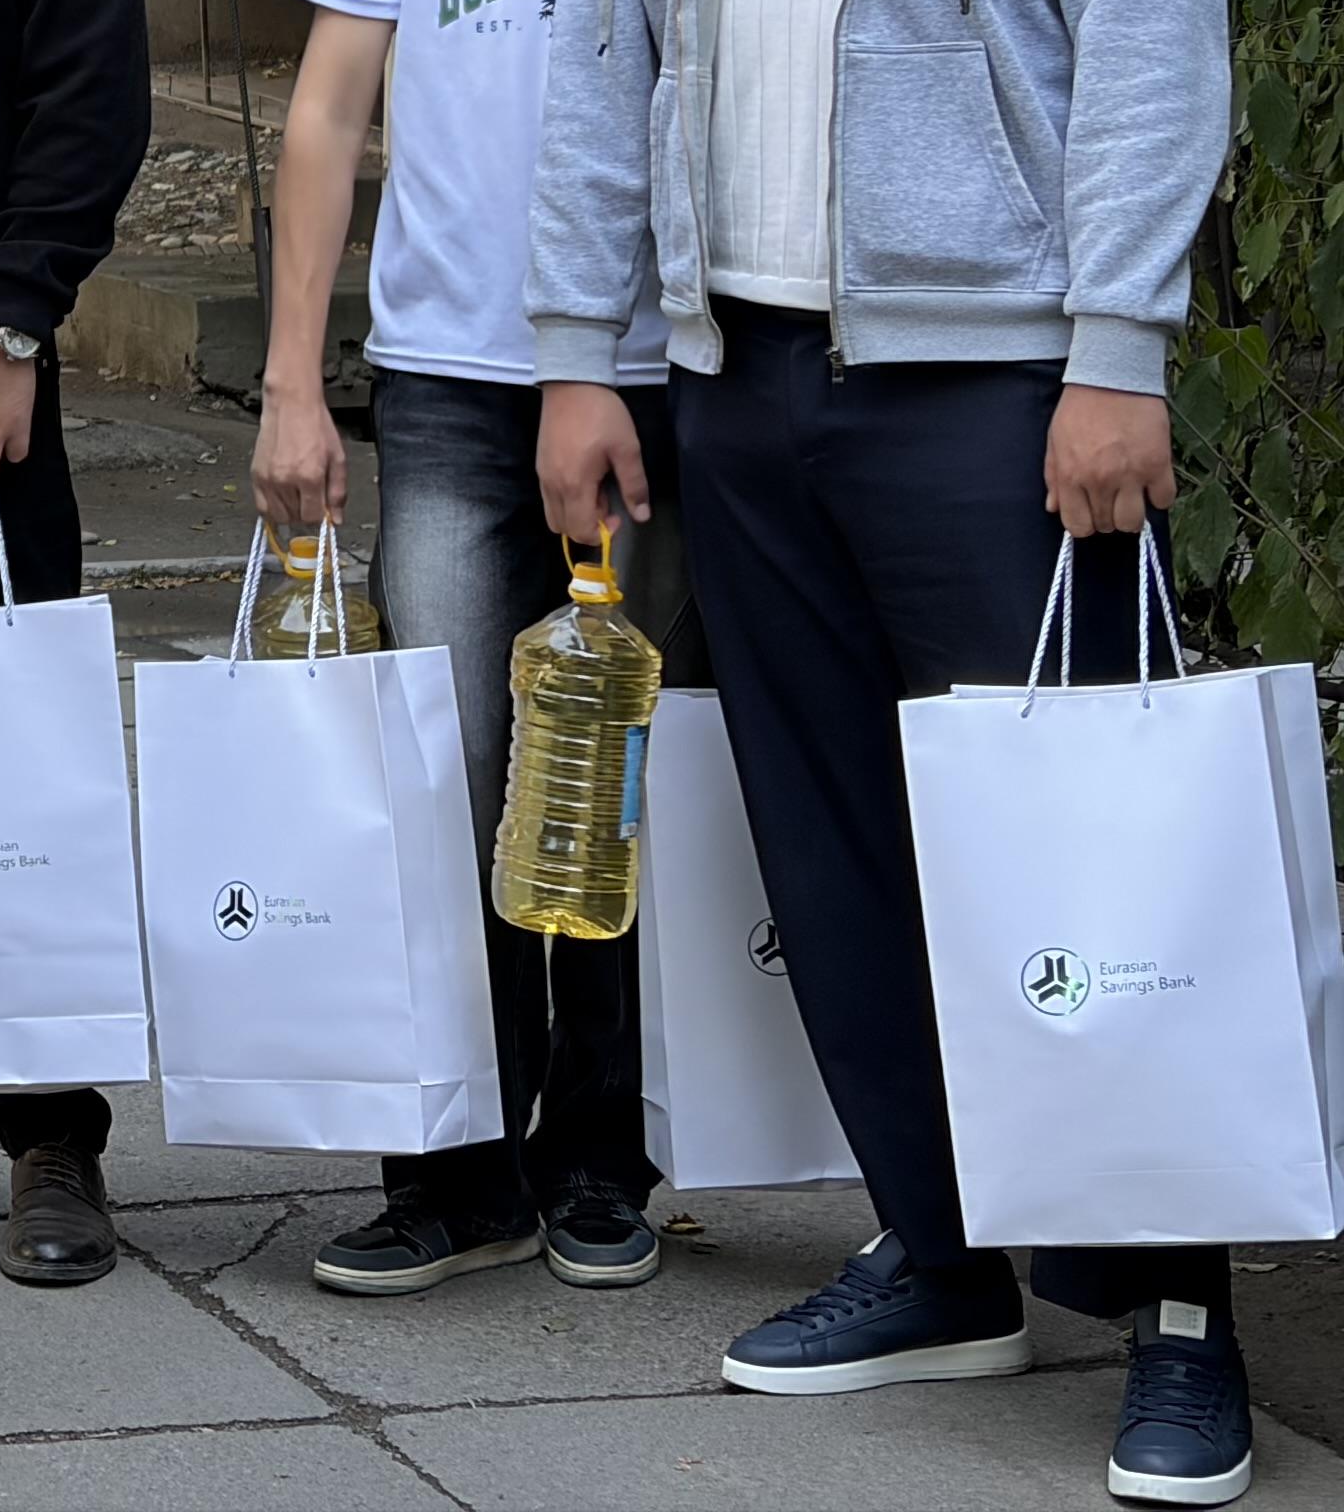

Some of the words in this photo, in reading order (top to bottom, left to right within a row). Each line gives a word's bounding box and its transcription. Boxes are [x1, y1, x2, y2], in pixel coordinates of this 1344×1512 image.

[475, 19, 522, 34] EST.
[19, 854, 51, 868] Bank
[264, 911, 303, 927] Sangs
[305, 911, 331, 924] Bank
[1099, 961, 1158, 976] Eurasian
[1100, 979, 1155, 996] Savings
[1158, 974, 1197, 990] Bank
